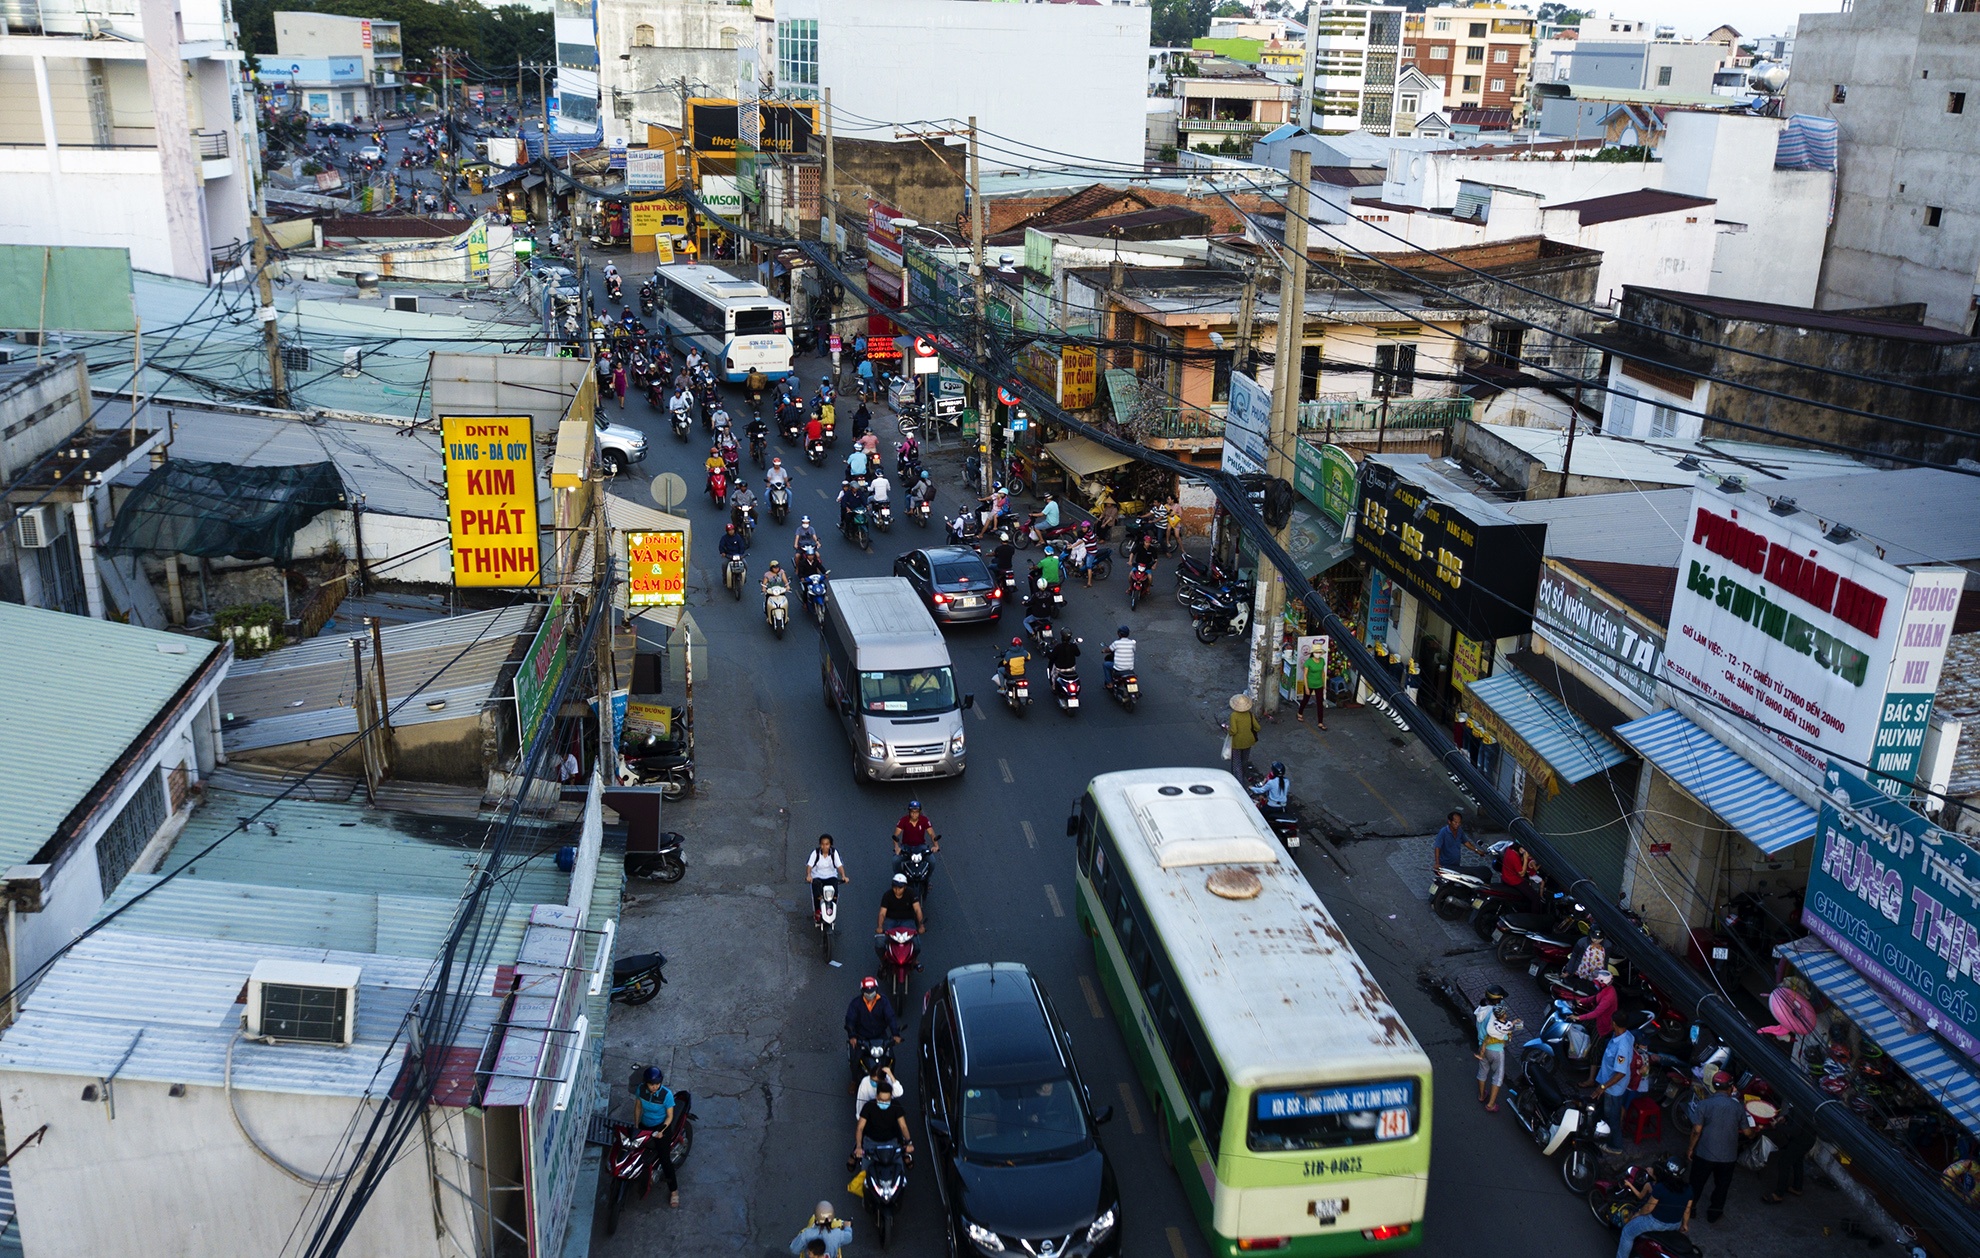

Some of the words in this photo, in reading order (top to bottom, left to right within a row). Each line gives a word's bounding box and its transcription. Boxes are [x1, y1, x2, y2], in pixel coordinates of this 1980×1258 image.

[466, 425, 509, 437] DNTN
[450, 440, 479, 461] VÀNG
[490, 440, 504, 460] ĐÁ
[467, 469, 515, 496] KIM
[460, 502, 526, 535] PHÁT
[633, 546, 680, 562] VÀNG
[1363, 497, 1388, 535] 135
[1399, 522, 1424, 561] 165
[1436, 547, 1463, 589] 195
[457, 547, 535, 579] THỊNH
[652, 563, 662, 574] &
[1692, 507, 1768, 575] PHÒNG
[1764, 542, 1839, 614] KHÁM
[1833, 576, 1888, 639] NHI
[1687, 559, 1715, 601] Bác
[1730, 585, 1788, 642] HUỲNH
[1909, 580, 1958, 612] PHÒNG
[1539, 578, 1553, 604] CƠ
[1551, 582, 1565, 613] SỞ
[1564, 594, 1590, 631] NHÔM
[1589, 609, 1618, 651] KIẾNG
[1903, 618, 1946, 648] KHÁM
[1682, 624, 1694, 640] GIỜ
[1693, 631, 1707, 647] LÀM
[1707, 639, 1724, 657] VIỆC:
[1728, 652, 1737, 666] T2
[1742, 661, 1752, 676] T7:
[1753, 668, 1773, 689] CHIỀU
[1773, 680, 1784, 694] TỪ
[1784, 687, 1805, 709] 17H00
[1805, 698, 1821, 718] ĐẾN
[1821, 711, 1845, 734] 20H00
[1902, 661, 1930, 684] NHI
[1724, 669, 1736, 685] CN:
[1736, 673, 1754, 696] SÁNG
[1755, 688, 1765, 702] TỪ
[1783, 705, 1798, 724] ĐẾN
[1798, 717, 1820, 738] 11H00
[1884, 699, 1911, 722] BÁC
[1914, 699, 1932, 722] SĨ
[1877, 724, 1924, 747] HUỲNH
[1877, 753, 1912, 771] MINH
[1876, 779, 1902, 797] THU
[1860, 806, 1915, 860] SHOP
[1920, 842, 1968, 898] THỂ
[1821, 825, 1904, 925] HƯNG
[1813, 891, 1881, 956] CHUYÊN
[1882, 942, 1934, 996] CUNG
[1936, 983, 1978, 1025] CẤP
[1806, 914, 1817, 928] 320
[1817, 921, 1826, 935] LÊ
[1826, 928, 1839, 945] VĂN
[1839, 938, 1854, 957] VIỆT
[1856, 954, 1863, 965] P.
[1864, 958, 1882, 979] TĂNG
[1901, 986, 1916, 1005] PHÚ
[1916, 999, 1923, 1010] B
[1955, 1030, 1973, 1049] HCM
[1380, 1110, 1406, 1138] 141
